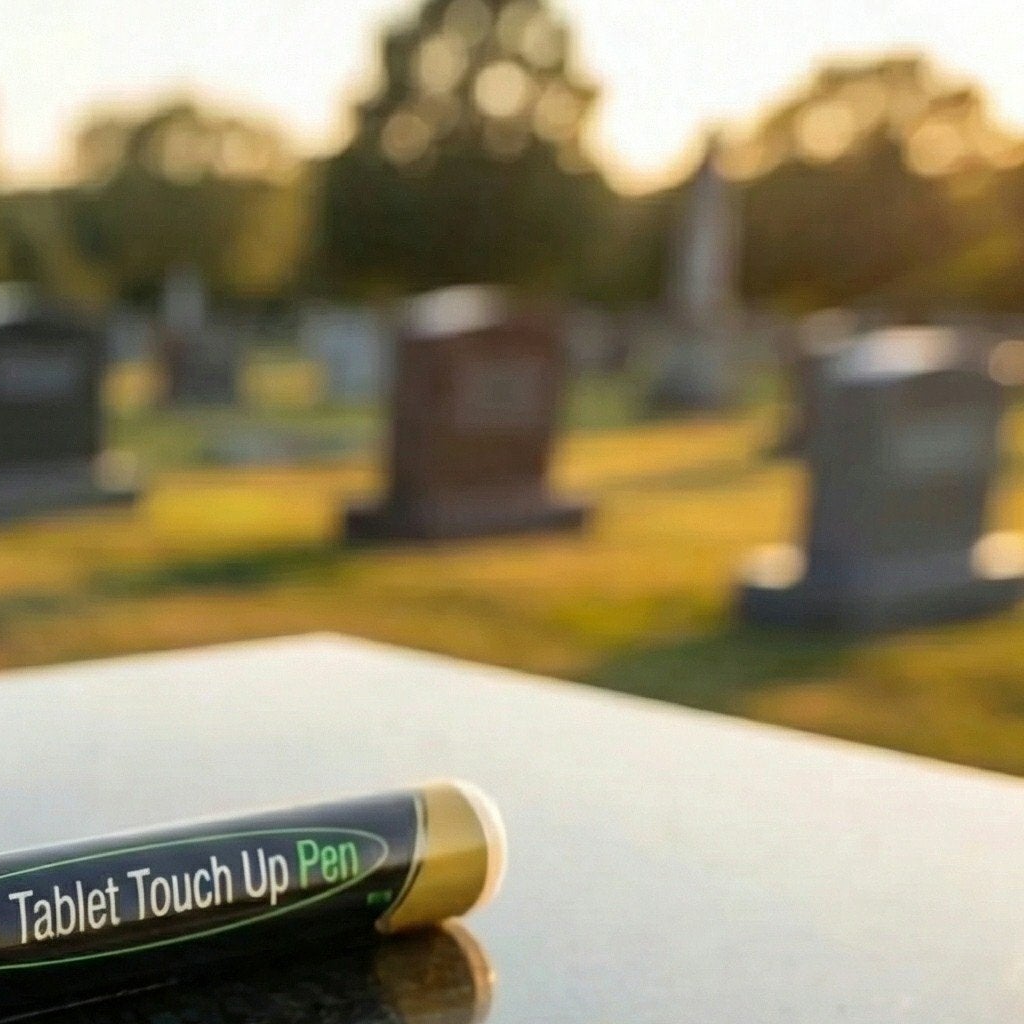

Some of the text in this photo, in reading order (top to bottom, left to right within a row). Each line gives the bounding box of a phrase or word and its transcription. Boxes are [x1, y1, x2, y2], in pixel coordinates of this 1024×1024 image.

[9, 878, 121, 944] Tablet
[127, 857, 234, 919] Touch
[241, 848, 291, 903] Up
[296, 839, 359, 888] Pen
